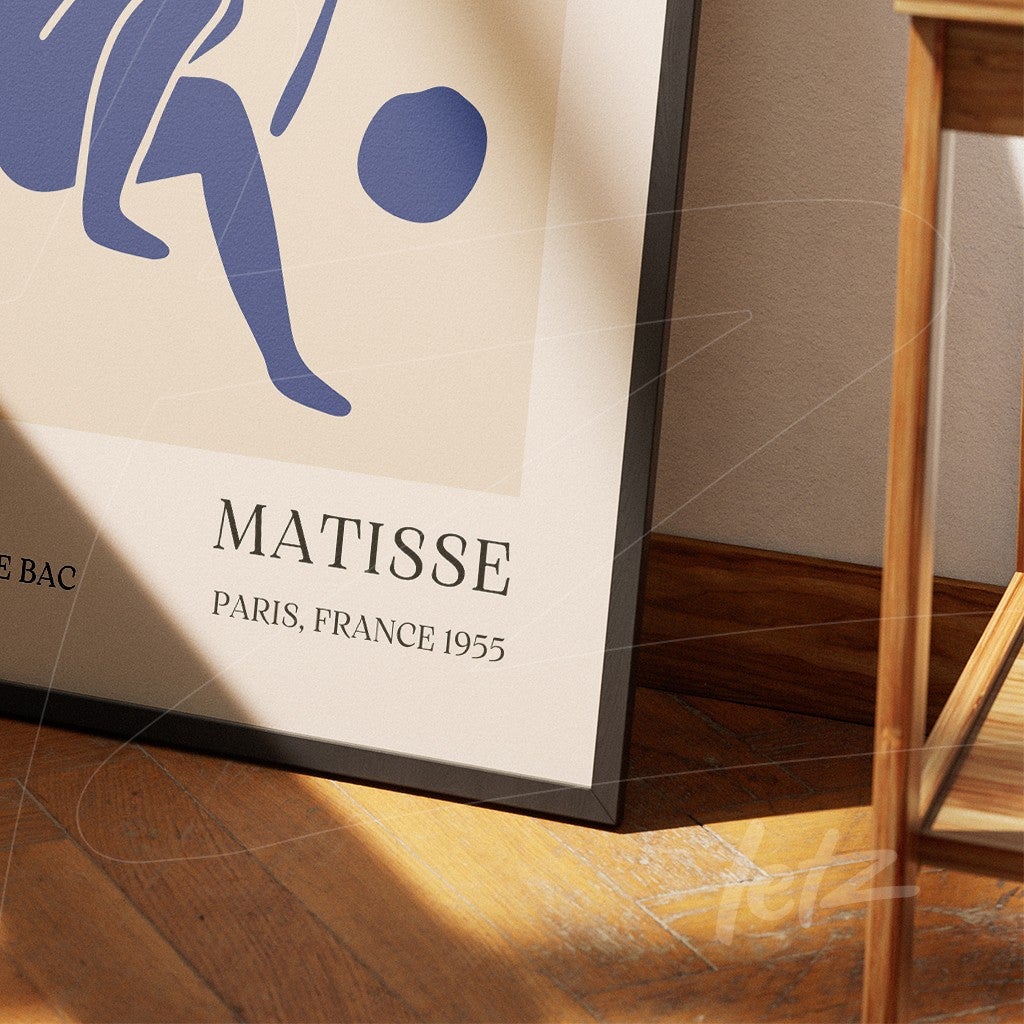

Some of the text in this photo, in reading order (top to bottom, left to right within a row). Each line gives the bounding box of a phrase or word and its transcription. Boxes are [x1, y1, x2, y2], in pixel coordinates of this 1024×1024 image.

[18, 557, 77, 591] BAC
[212, 497, 510, 597] MATISSE
[211, 589, 506, 662] PARIS, FRANCE 1955
